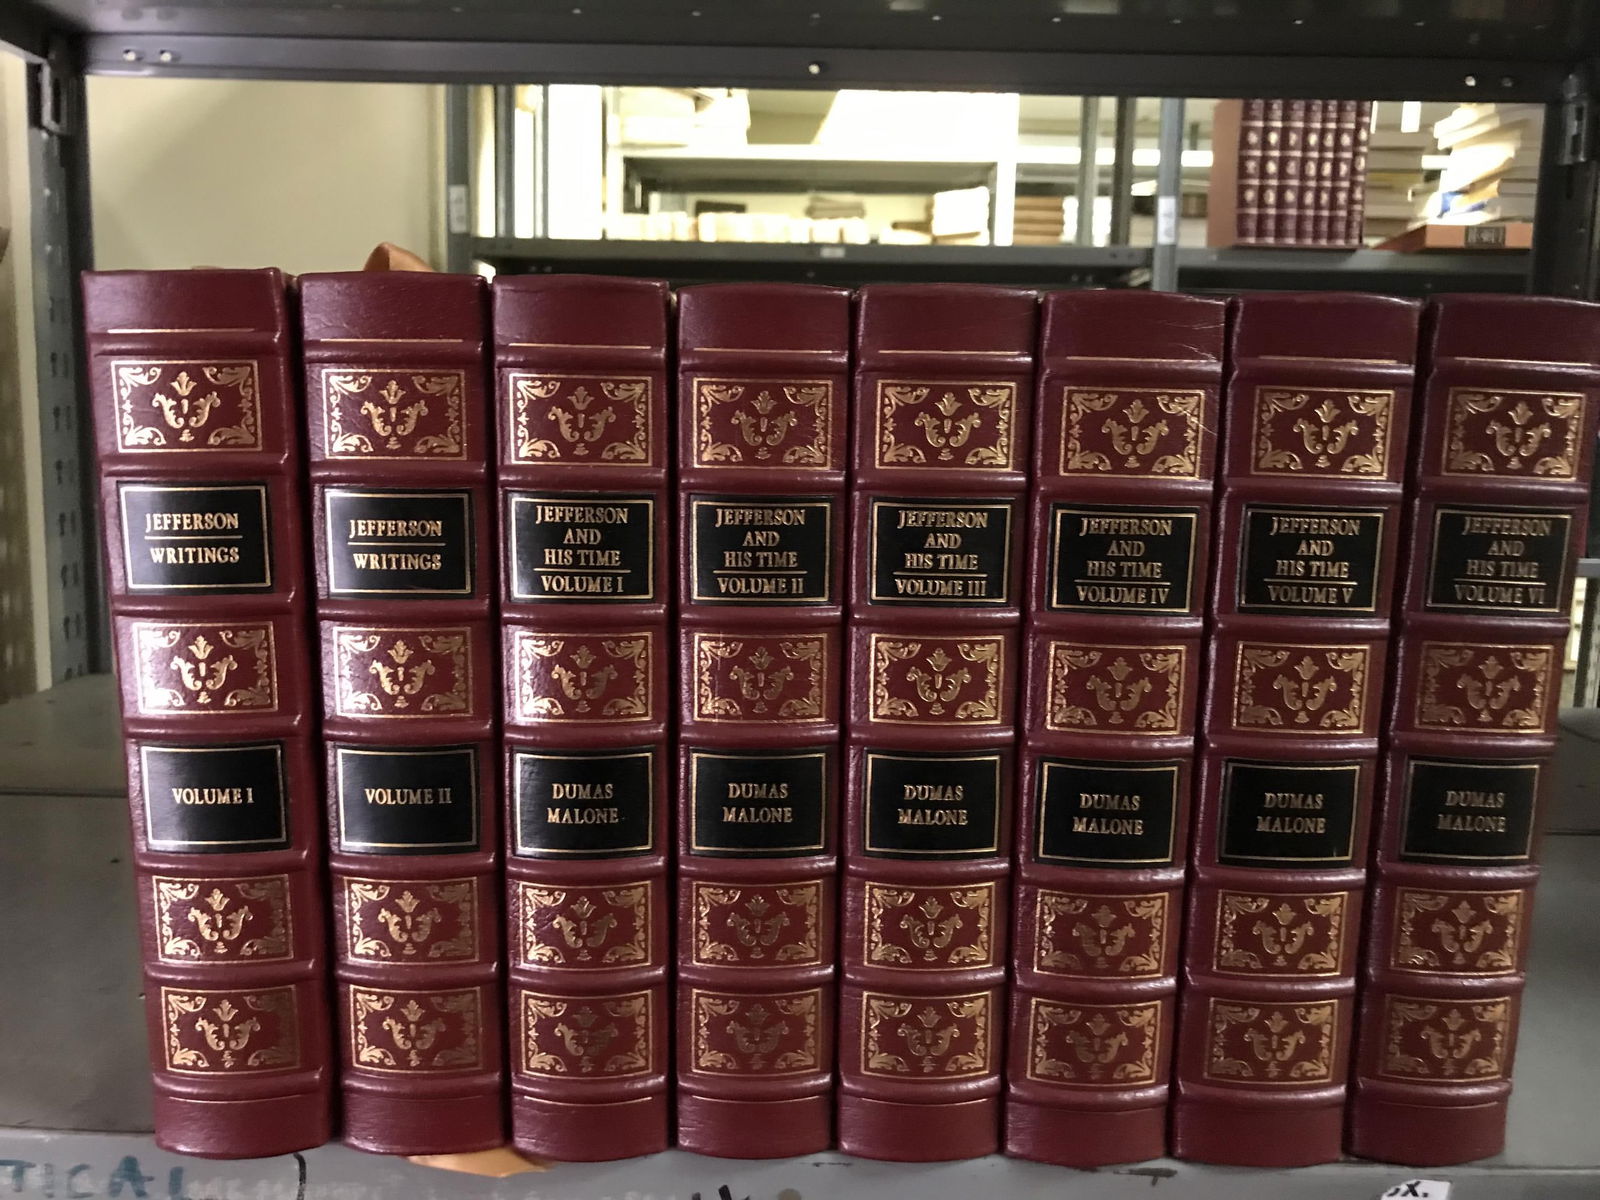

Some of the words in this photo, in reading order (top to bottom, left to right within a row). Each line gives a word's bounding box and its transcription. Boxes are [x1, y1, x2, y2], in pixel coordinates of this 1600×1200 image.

[145, 513, 239, 532] JEFFERSON
[536, 505, 628, 524] JEFFERSON
[715, 509, 805, 526] JEFFERSON
[897, 511, 988, 529] JEFFERSON
[349, 520, 442, 538] JEFFERSON
[1080, 518, 1172, 536] JEFFERSON
[1270, 517, 1360, 536] JEFFERSON
[1462, 517, 1550, 536] JEFFERSON
[563, 529, 601, 545] AND
[743, 531, 780, 547] AND
[924, 533, 961, 549] AND
[150, 547, 240, 564] WRITINGS
[1107, 541, 1145, 557] AND
[1296, 540, 1334, 556] AND
[1488, 541, 1525, 556] AND
[353, 553, 441, 570] WRITINGS
[544, 549, 572, 566] HIS
[577, 549, 621, 566] TIME
[724, 551, 752, 568] HIS
[757, 552, 798, 568] TIME
[905, 554, 933, 569] HIS
[937, 554, 978, 570] TIME
[1087, 560, 1116, 578] HIS
[1120, 561, 1162, 578] TIME
[1276, 560, 1305, 576] HIS
[1310, 561, 1349, 578] TIME
[1466, 559, 1494, 576] HIS
[1499, 560, 1538, 578] TIME
[541, 575, 613, 593] VOLUME
[616, 577, 624, 593] I
[717, 577, 787, 594] VOLUME
[791, 578, 804, 594] II
[895, 579, 964, 596] VOLUME
[967, 580, 986, 596] III
[1076, 586, 1147, 604] VOLUME
[1150, 588, 1170, 605] IV
[1267, 585, 1337, 604] VOLUME
[1341, 588, 1354, 604] V
[1454, 585, 1524, 604] VOLUME
[1527, 588, 1544, 604] VI
[172, 788, 243, 804] VOLUME
[246, 788, 254, 803] I
[365, 788, 435, 805] VOLUME
[438, 788, 452, 804] II
[552, 783, 613, 800] DUMAS
[728, 783, 788, 799] DUMAS
[904, 785, 963, 801] DUMAS
[1445, 791, 1505, 808] DUMAS
[1080, 793, 1140, 811] DUMAS
[1264, 792, 1323, 809] DUMAS
[547, 808, 619, 824] MALONE
[722, 807, 793, 823] MALONE
[898, 809, 968, 825] MALONE
[1438, 815, 1506, 832] MALONE
[1072, 817, 1143, 835] MALONE
[1256, 816, 1325, 833] MALONE
